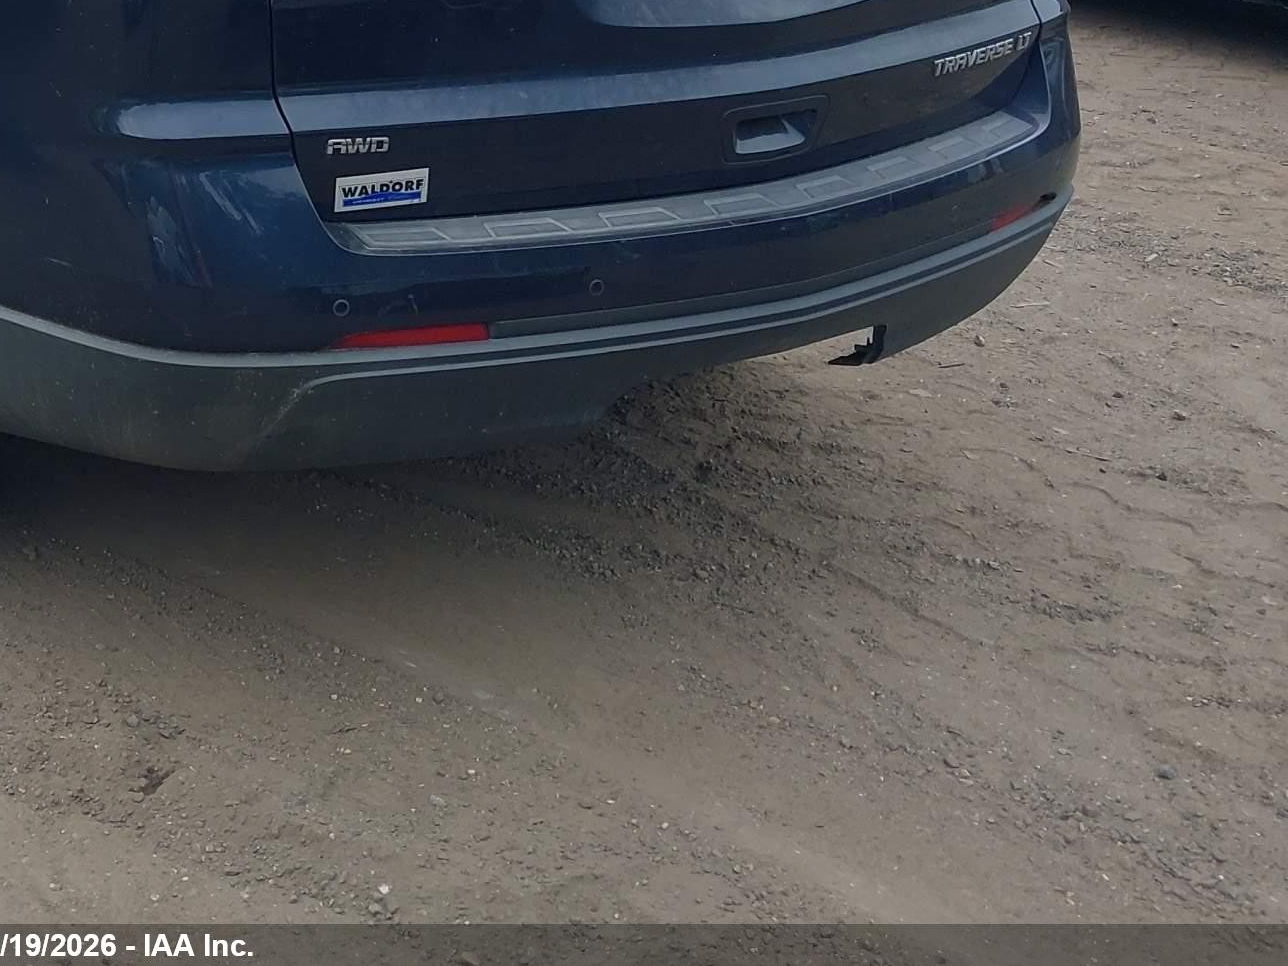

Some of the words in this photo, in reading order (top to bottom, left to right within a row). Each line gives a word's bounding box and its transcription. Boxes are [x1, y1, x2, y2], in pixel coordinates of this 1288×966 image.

[934, 38, 1014, 77] TRAVERSE
[1016, 31, 1032, 51] LT
[326, 136, 390, 155] AWD
[342, 178, 425, 198] WALDORF
